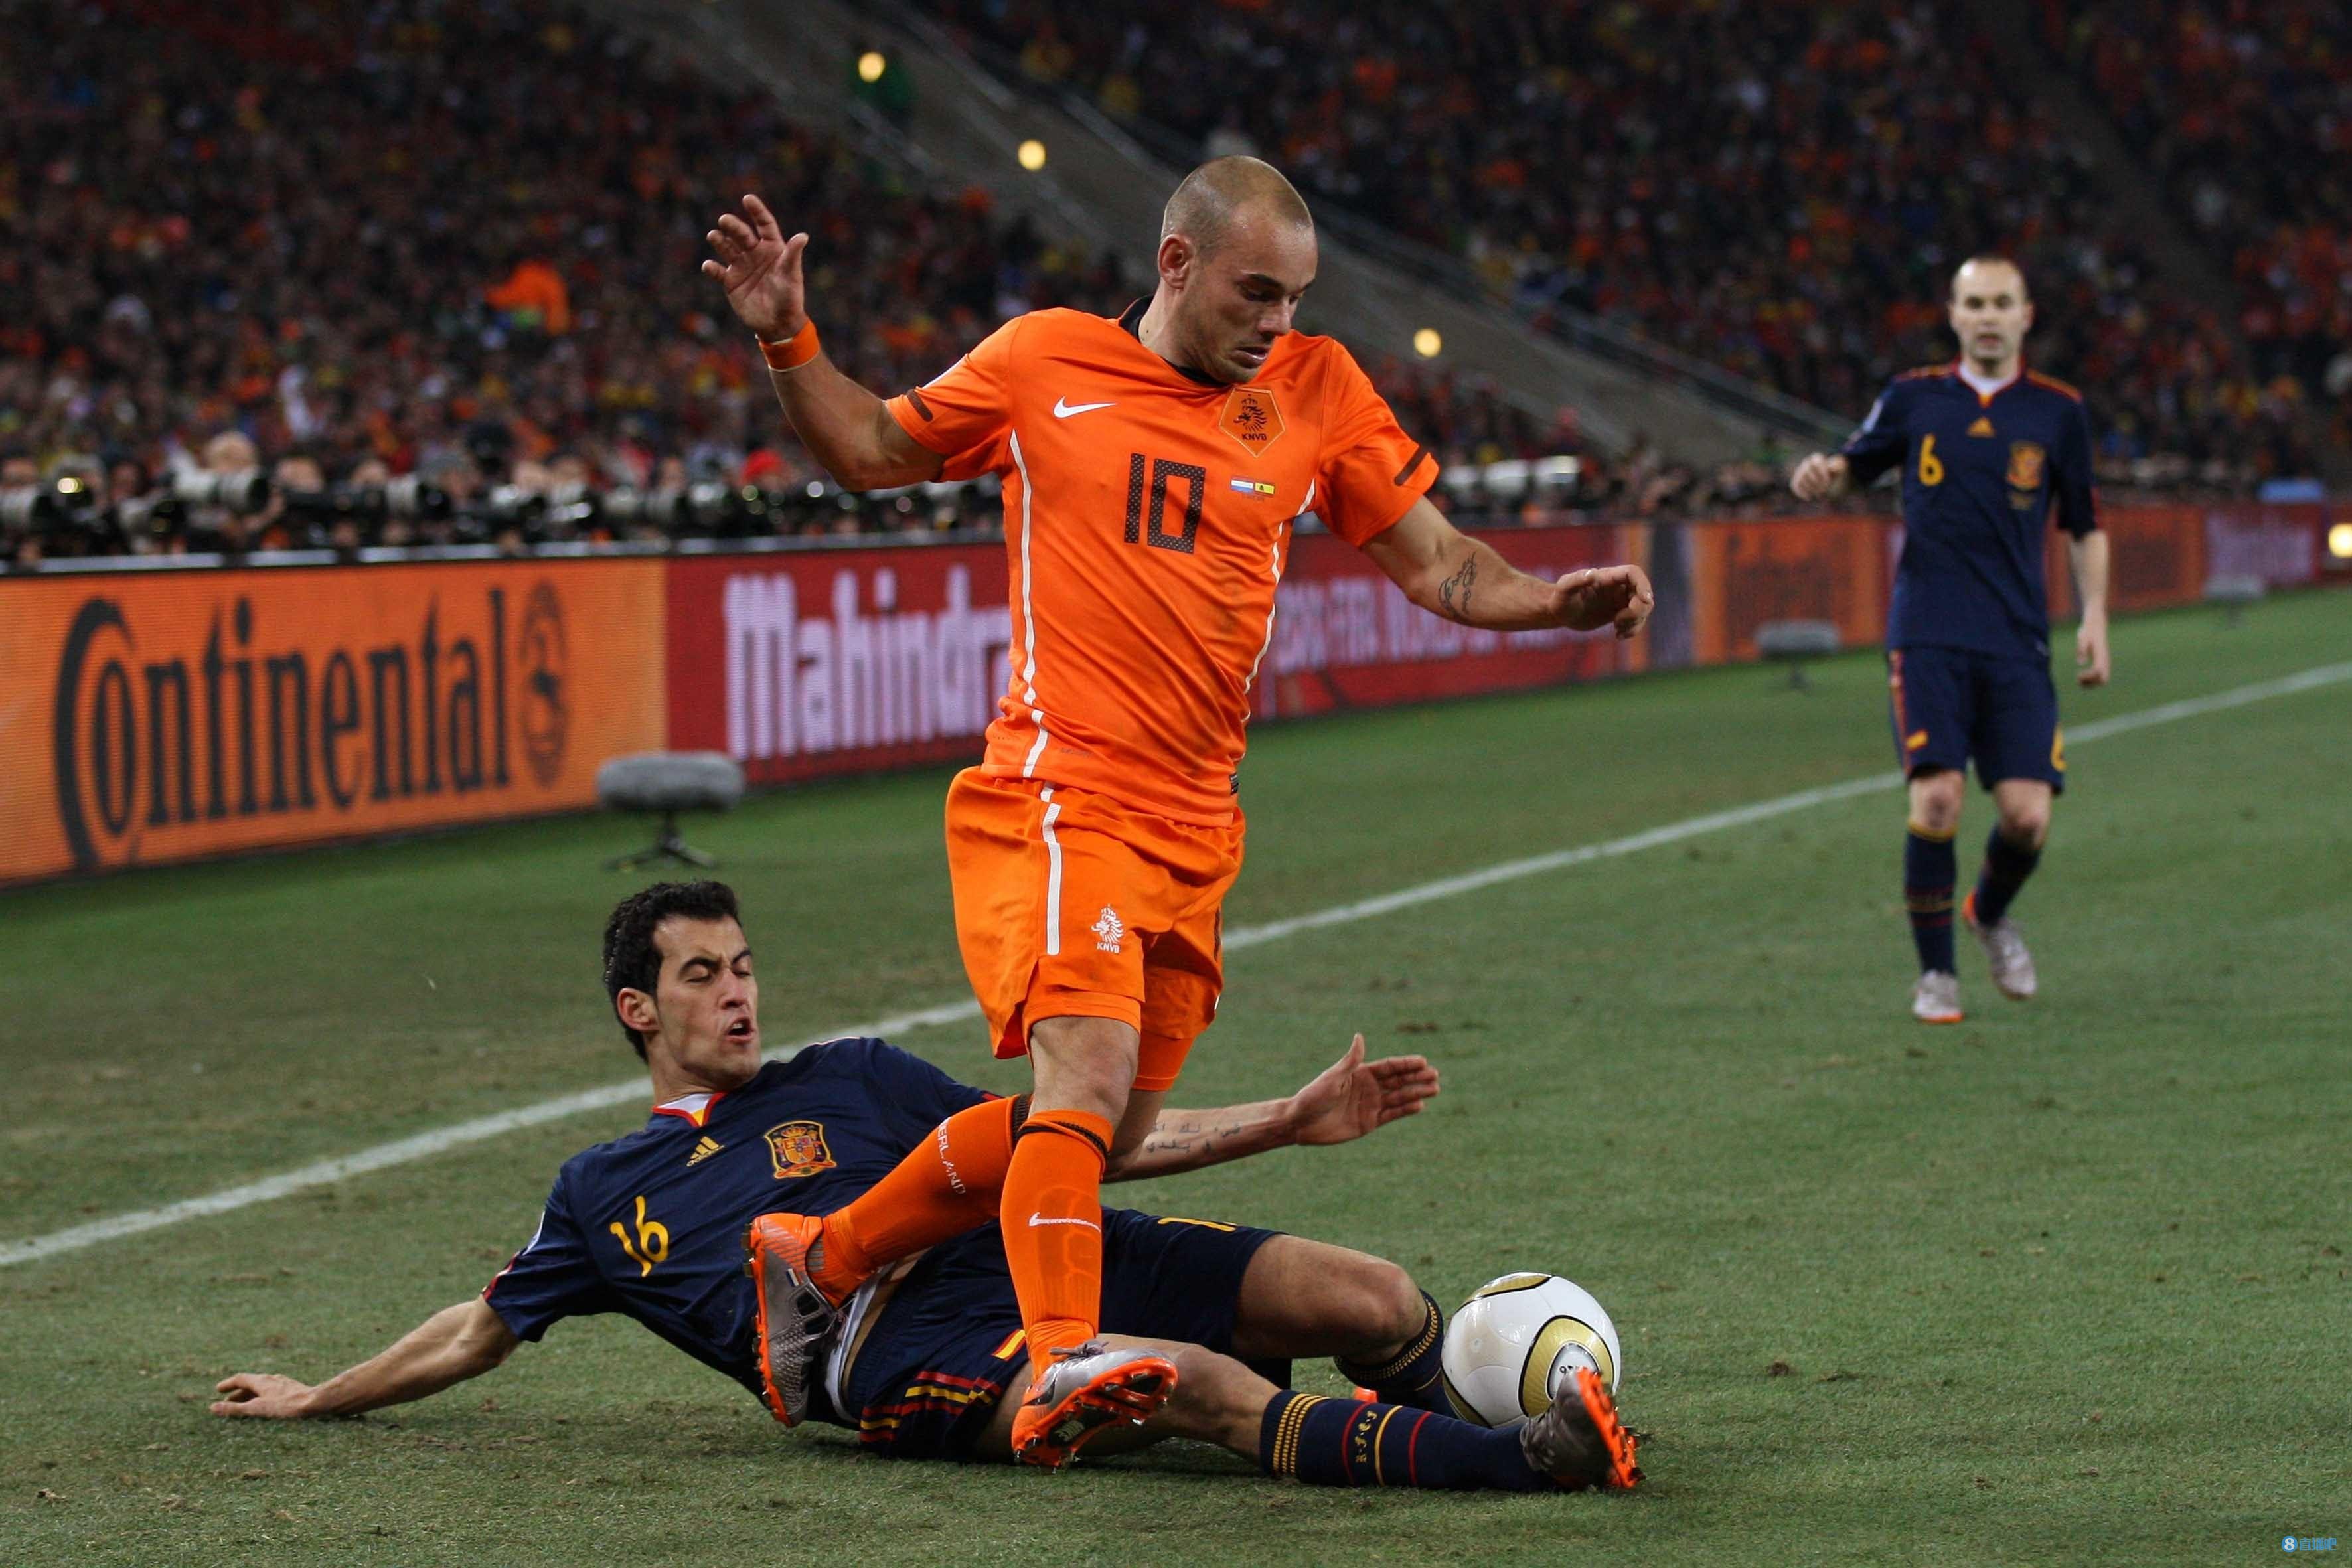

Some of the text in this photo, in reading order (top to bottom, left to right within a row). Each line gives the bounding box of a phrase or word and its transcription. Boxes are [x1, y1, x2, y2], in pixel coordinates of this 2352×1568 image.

[1918, 433, 1945, 487] 6
[1124, 453, 1206, 554] 10
[54, 584, 512, 872] Continental
[1096, 941, 1121, 954] KNVB
[609, 1195, 669, 1277] 16
